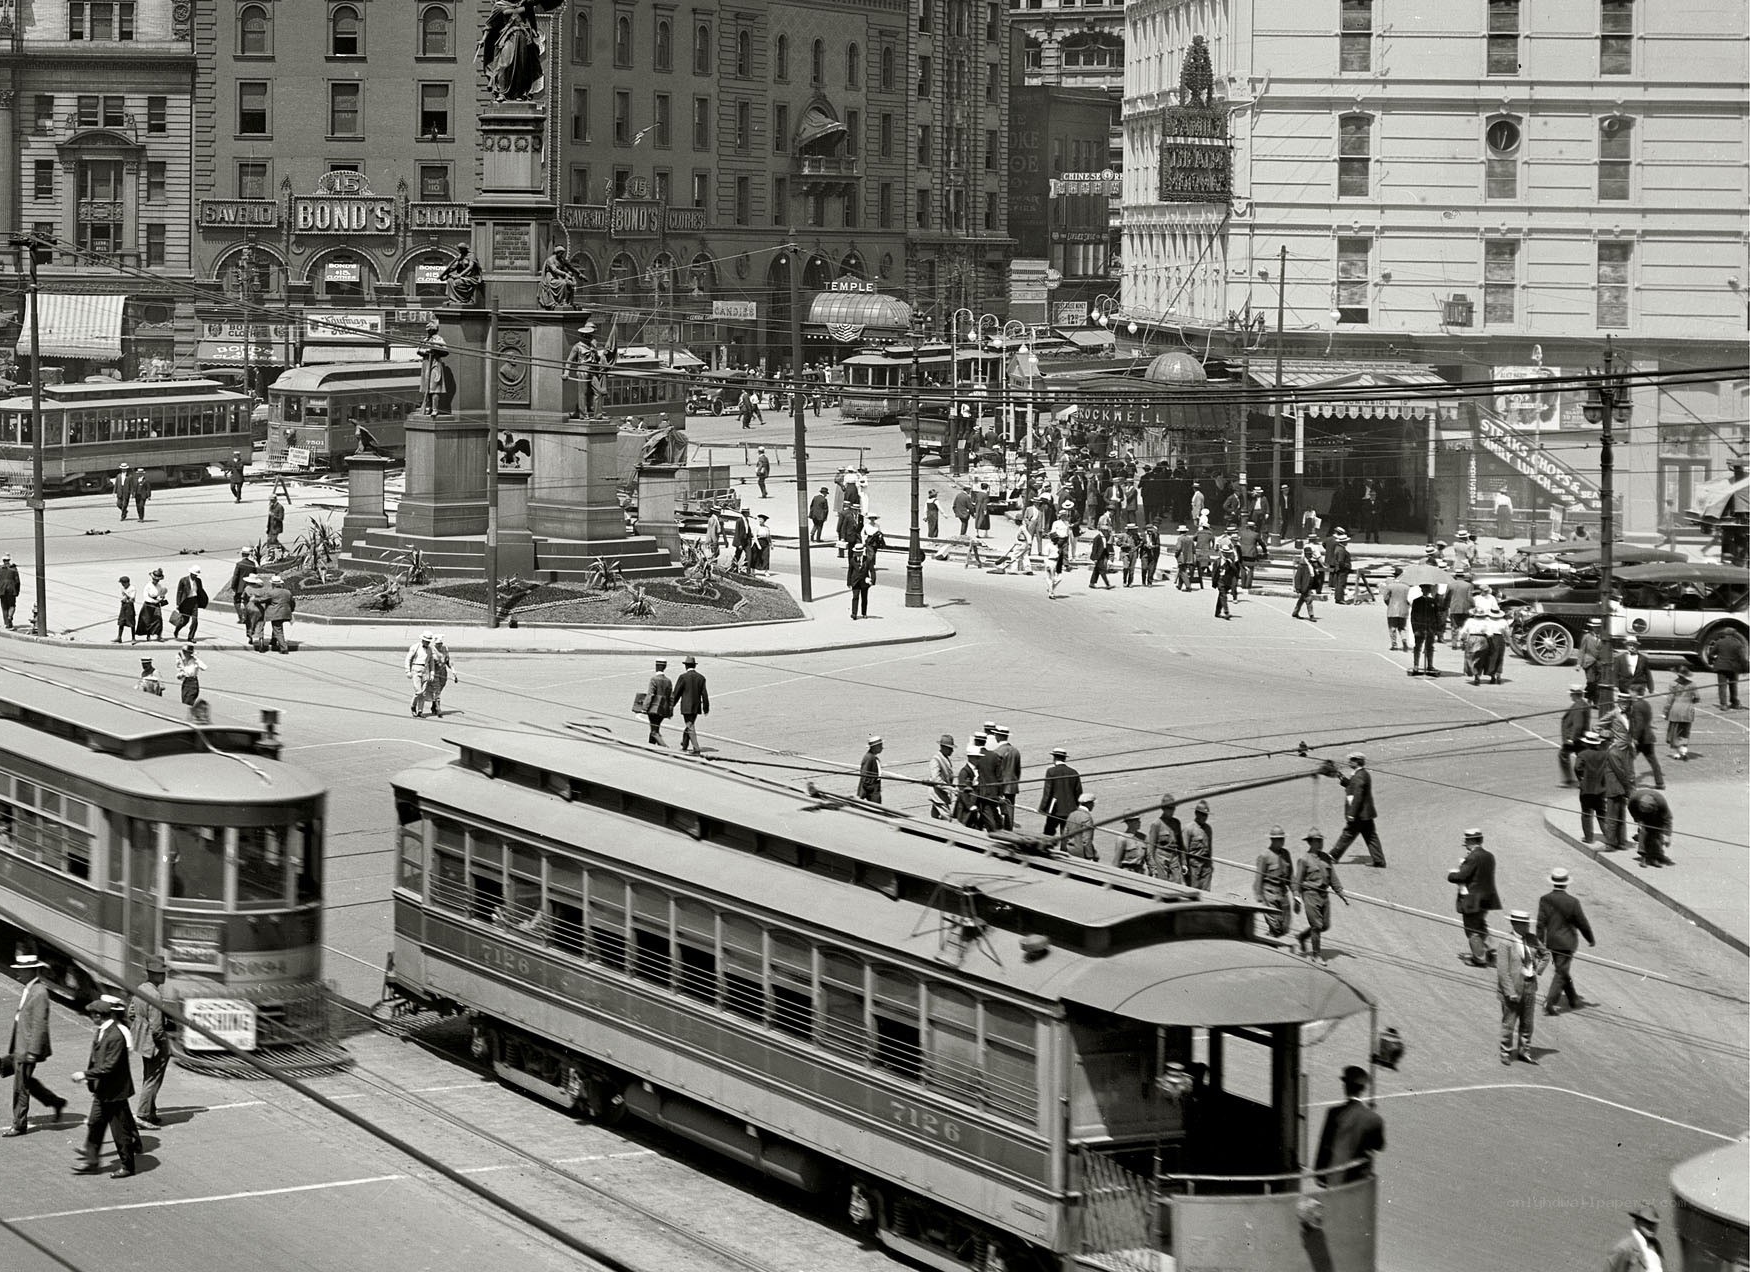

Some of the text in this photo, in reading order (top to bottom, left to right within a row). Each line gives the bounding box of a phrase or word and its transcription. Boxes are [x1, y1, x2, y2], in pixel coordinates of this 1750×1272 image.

[1063, 172, 1101, 180] CHINESE
[299, 200, 392, 230] BOND'S
[565, 209, 589, 228] SAVE
[616, 206, 658, 231] BOND'S
[669, 214, 703, 229] CLOTHES
[823, 281, 874, 292] TEMPLE
[714, 305, 755, 317] CANDIES
[1517, 457, 1551, 490] LUNCH
[1530, 454, 1572, 488] CHOPS
[1569, 481, 1581, 494] &
